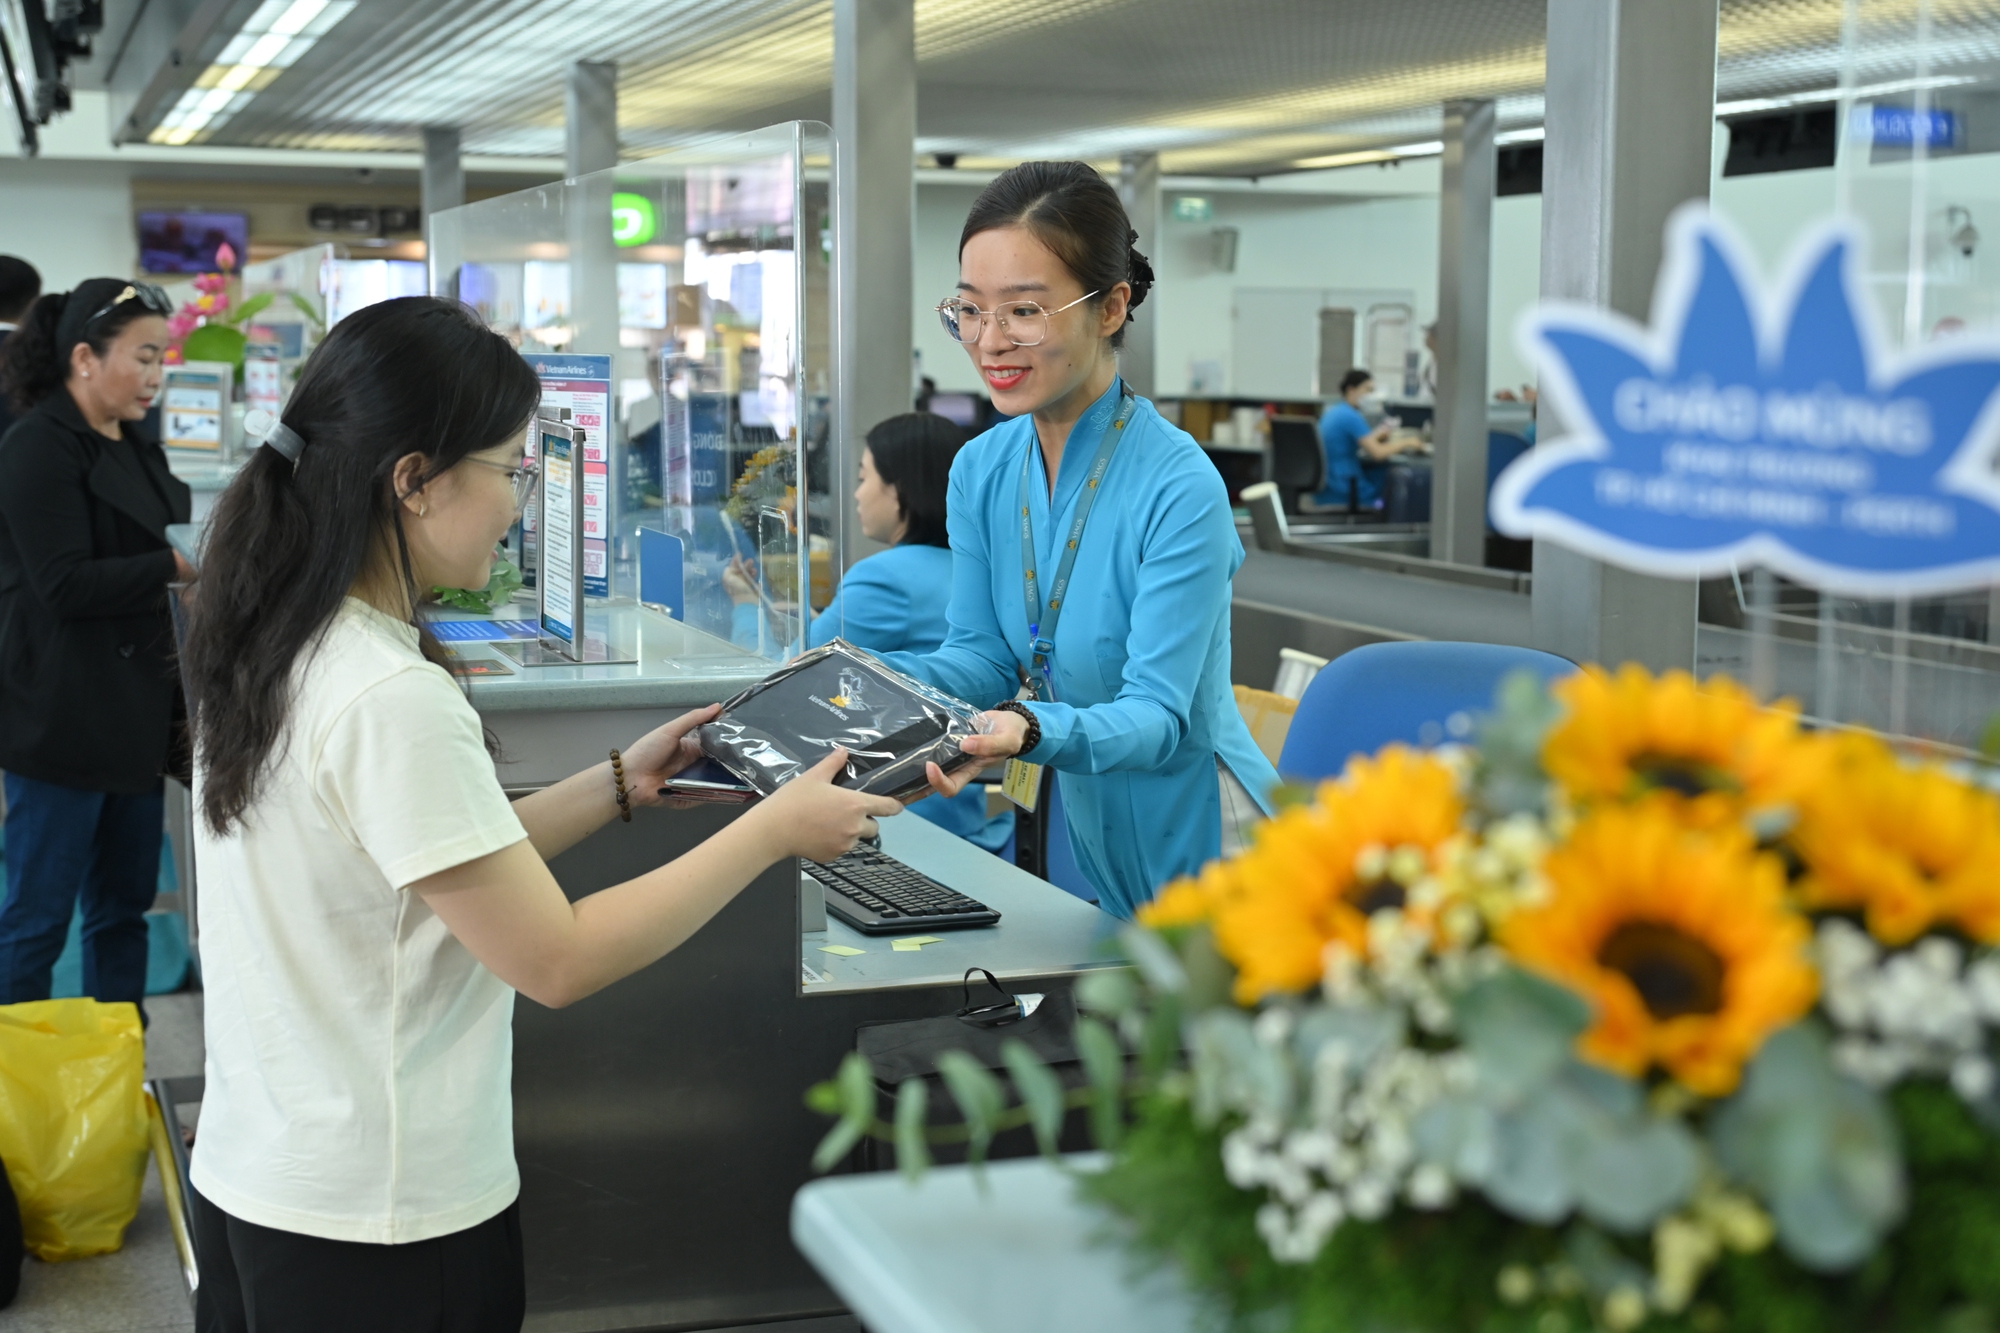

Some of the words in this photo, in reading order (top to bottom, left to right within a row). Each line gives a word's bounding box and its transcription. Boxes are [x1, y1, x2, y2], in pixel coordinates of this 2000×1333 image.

[1119, 401, 1132, 419] VIAGS
[1093, 457, 1106, 478] VIAGS
[1072, 518, 1082, 538] VIAGS
[1026, 580, 1035, 602] VIAGS
[1054, 578, 1065, 599] VIAGS
